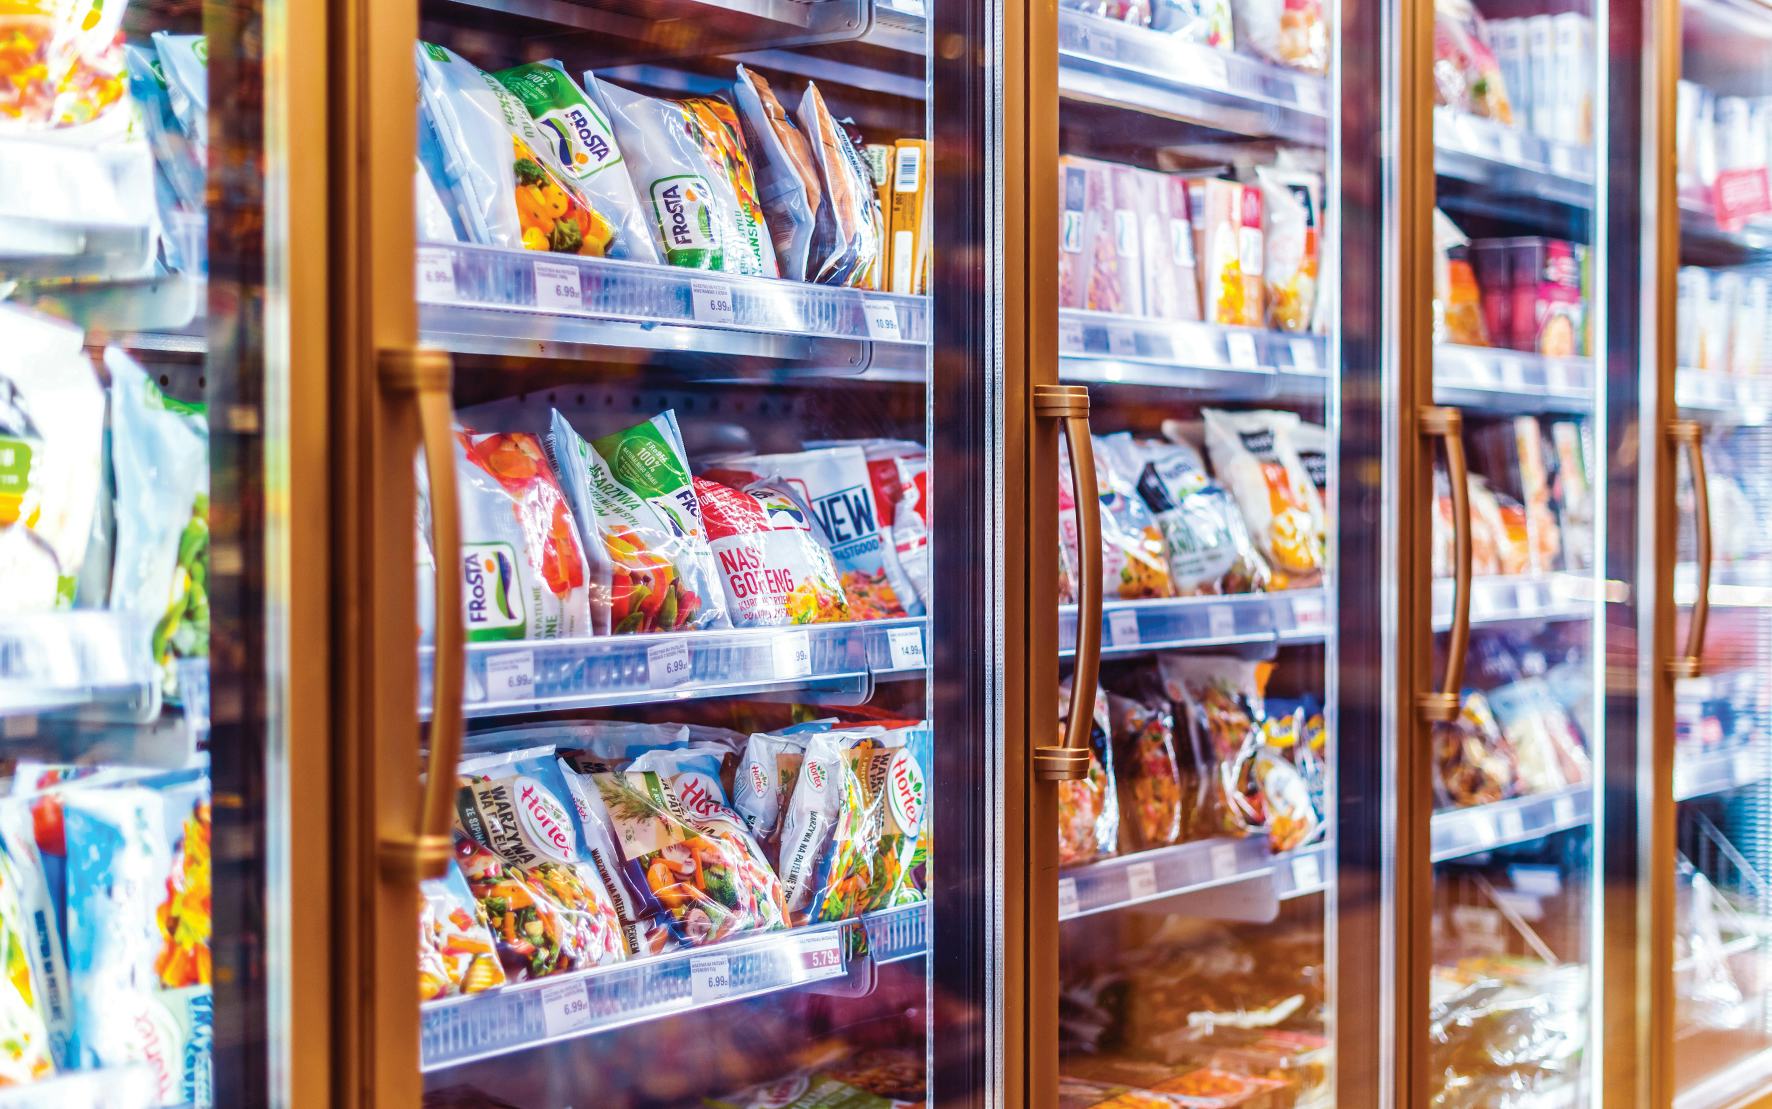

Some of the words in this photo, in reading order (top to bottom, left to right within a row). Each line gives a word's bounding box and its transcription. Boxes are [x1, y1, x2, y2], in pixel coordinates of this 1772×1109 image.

[564, 109, 610, 163] FRoSTA
[663, 184, 692, 246] FRoSTA
[636, 447, 662, 473] 100%
[590, 462, 642, 512] WARZYWA
[718, 543, 765, 576] NAS
[466, 554, 488, 623] FRoSTA
[807, 760, 823, 789] Hortex
[870, 755, 880, 771] NA
[751, 764, 763, 795] Hortex
[893, 757, 919, 829] Hortex
[478, 788, 494, 810] NA
[468, 816, 486, 847] SZPINA
[490, 785, 537, 865] WARZYWA
[802, 811, 820, 843] WARZYWA
[798, 843, 808, 854] NA
[591, 848, 612, 884] WARZYWA
[607, 883, 618, 895] NA
[812, 950, 840, 967] 5.79zł
